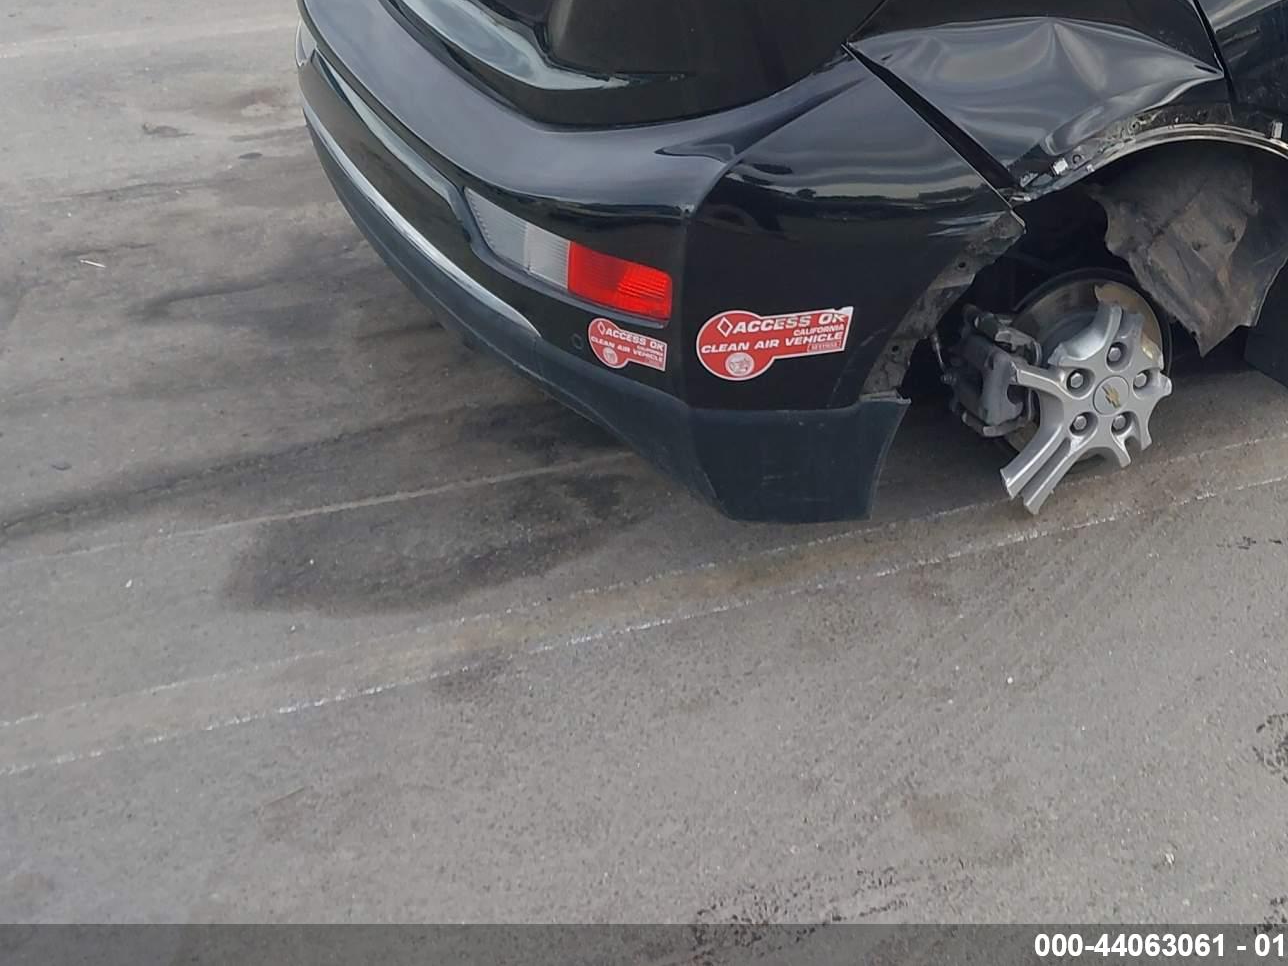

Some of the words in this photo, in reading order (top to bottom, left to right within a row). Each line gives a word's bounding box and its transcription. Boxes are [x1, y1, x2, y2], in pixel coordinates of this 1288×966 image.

[732, 315, 812, 334] ACCESS
[818, 313, 846, 325] OK
[793, 324, 845, 336] CALIFORNIA
[591, 336, 615, 349] CLEAN
[616, 344, 631, 353] AIR
[633, 348, 663, 362] VEHICLE
[605, 328, 647, 345] ACCESS
[649, 341, 665, 351] OK
[701, 341, 750, 354] CLEAN
[754, 338, 780, 350] AIR
[785, 331, 844, 347] VEHICLE
